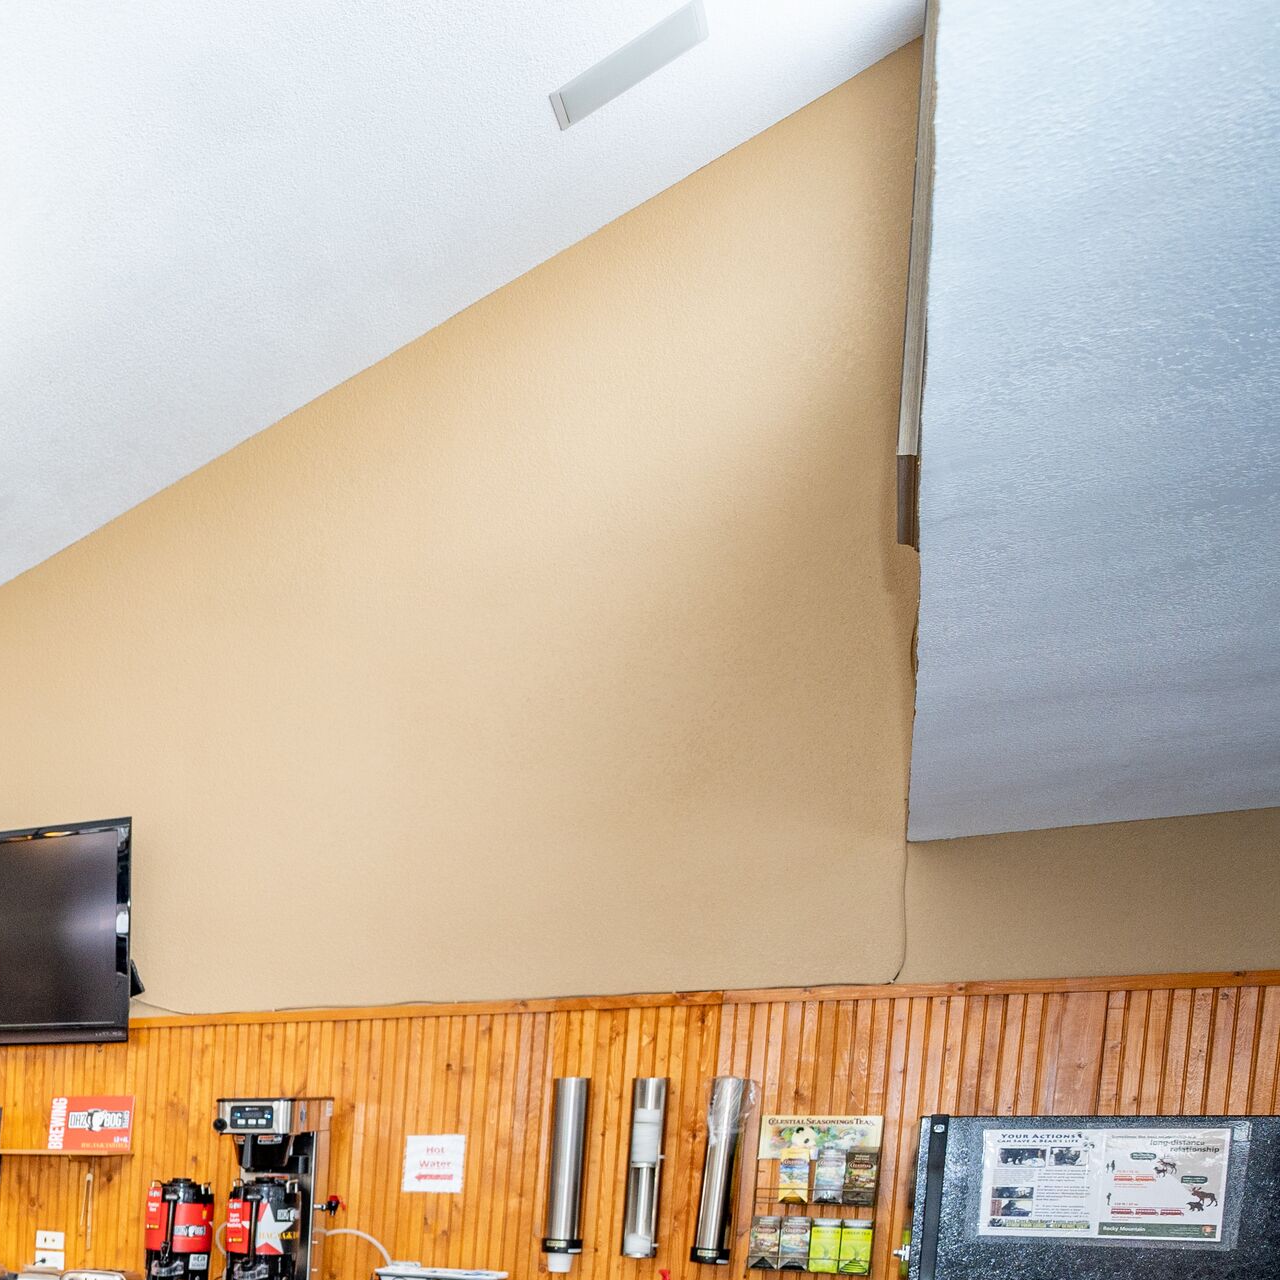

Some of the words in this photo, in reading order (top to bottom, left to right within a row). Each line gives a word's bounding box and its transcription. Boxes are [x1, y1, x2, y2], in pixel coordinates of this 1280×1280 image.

[47, 1097, 68, 1150] BREWING
[768, 1117, 805, 1126] CELESTIAL
[806, 1117, 854, 1126] SEASONINGS
[426, 1146, 446, 1154] Hot
[1170, 1146, 1220, 1154] relationship
[419, 1160, 452, 1168] Water
